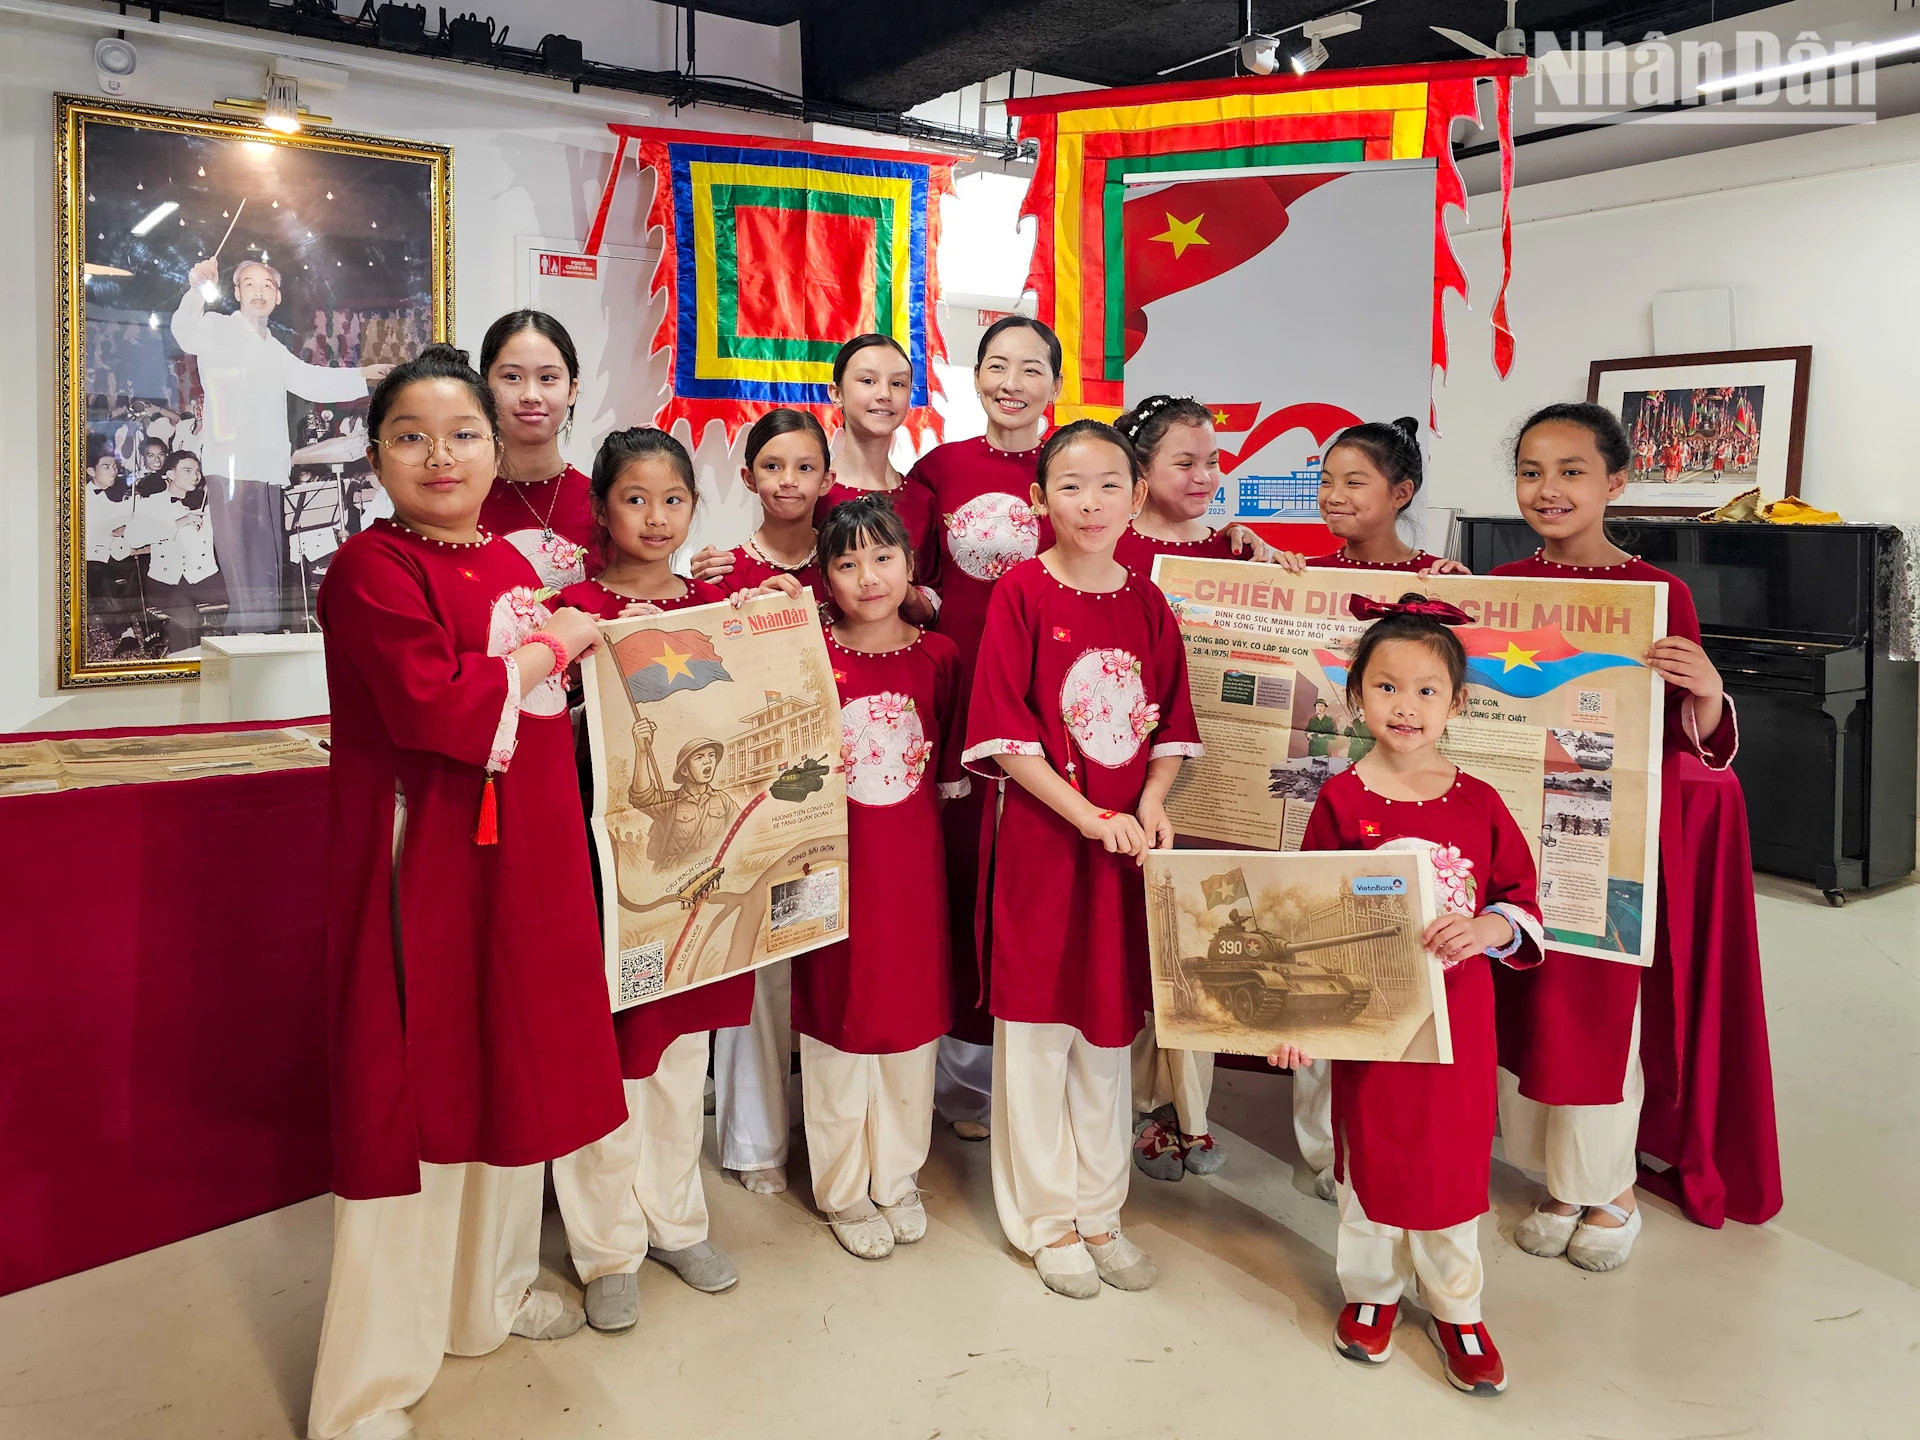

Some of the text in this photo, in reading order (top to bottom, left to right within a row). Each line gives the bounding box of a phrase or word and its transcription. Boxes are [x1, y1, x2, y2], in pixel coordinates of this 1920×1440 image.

[1208, 507, 1226, 515] 2025
[1235, 613, 1252, 621] CAO
[1531, 603, 1632, 635] MINH
[1213, 619, 1231, 627] NON
[1214, 637, 1229, 646] BAO
[1218, 939, 1243, 955] 390
